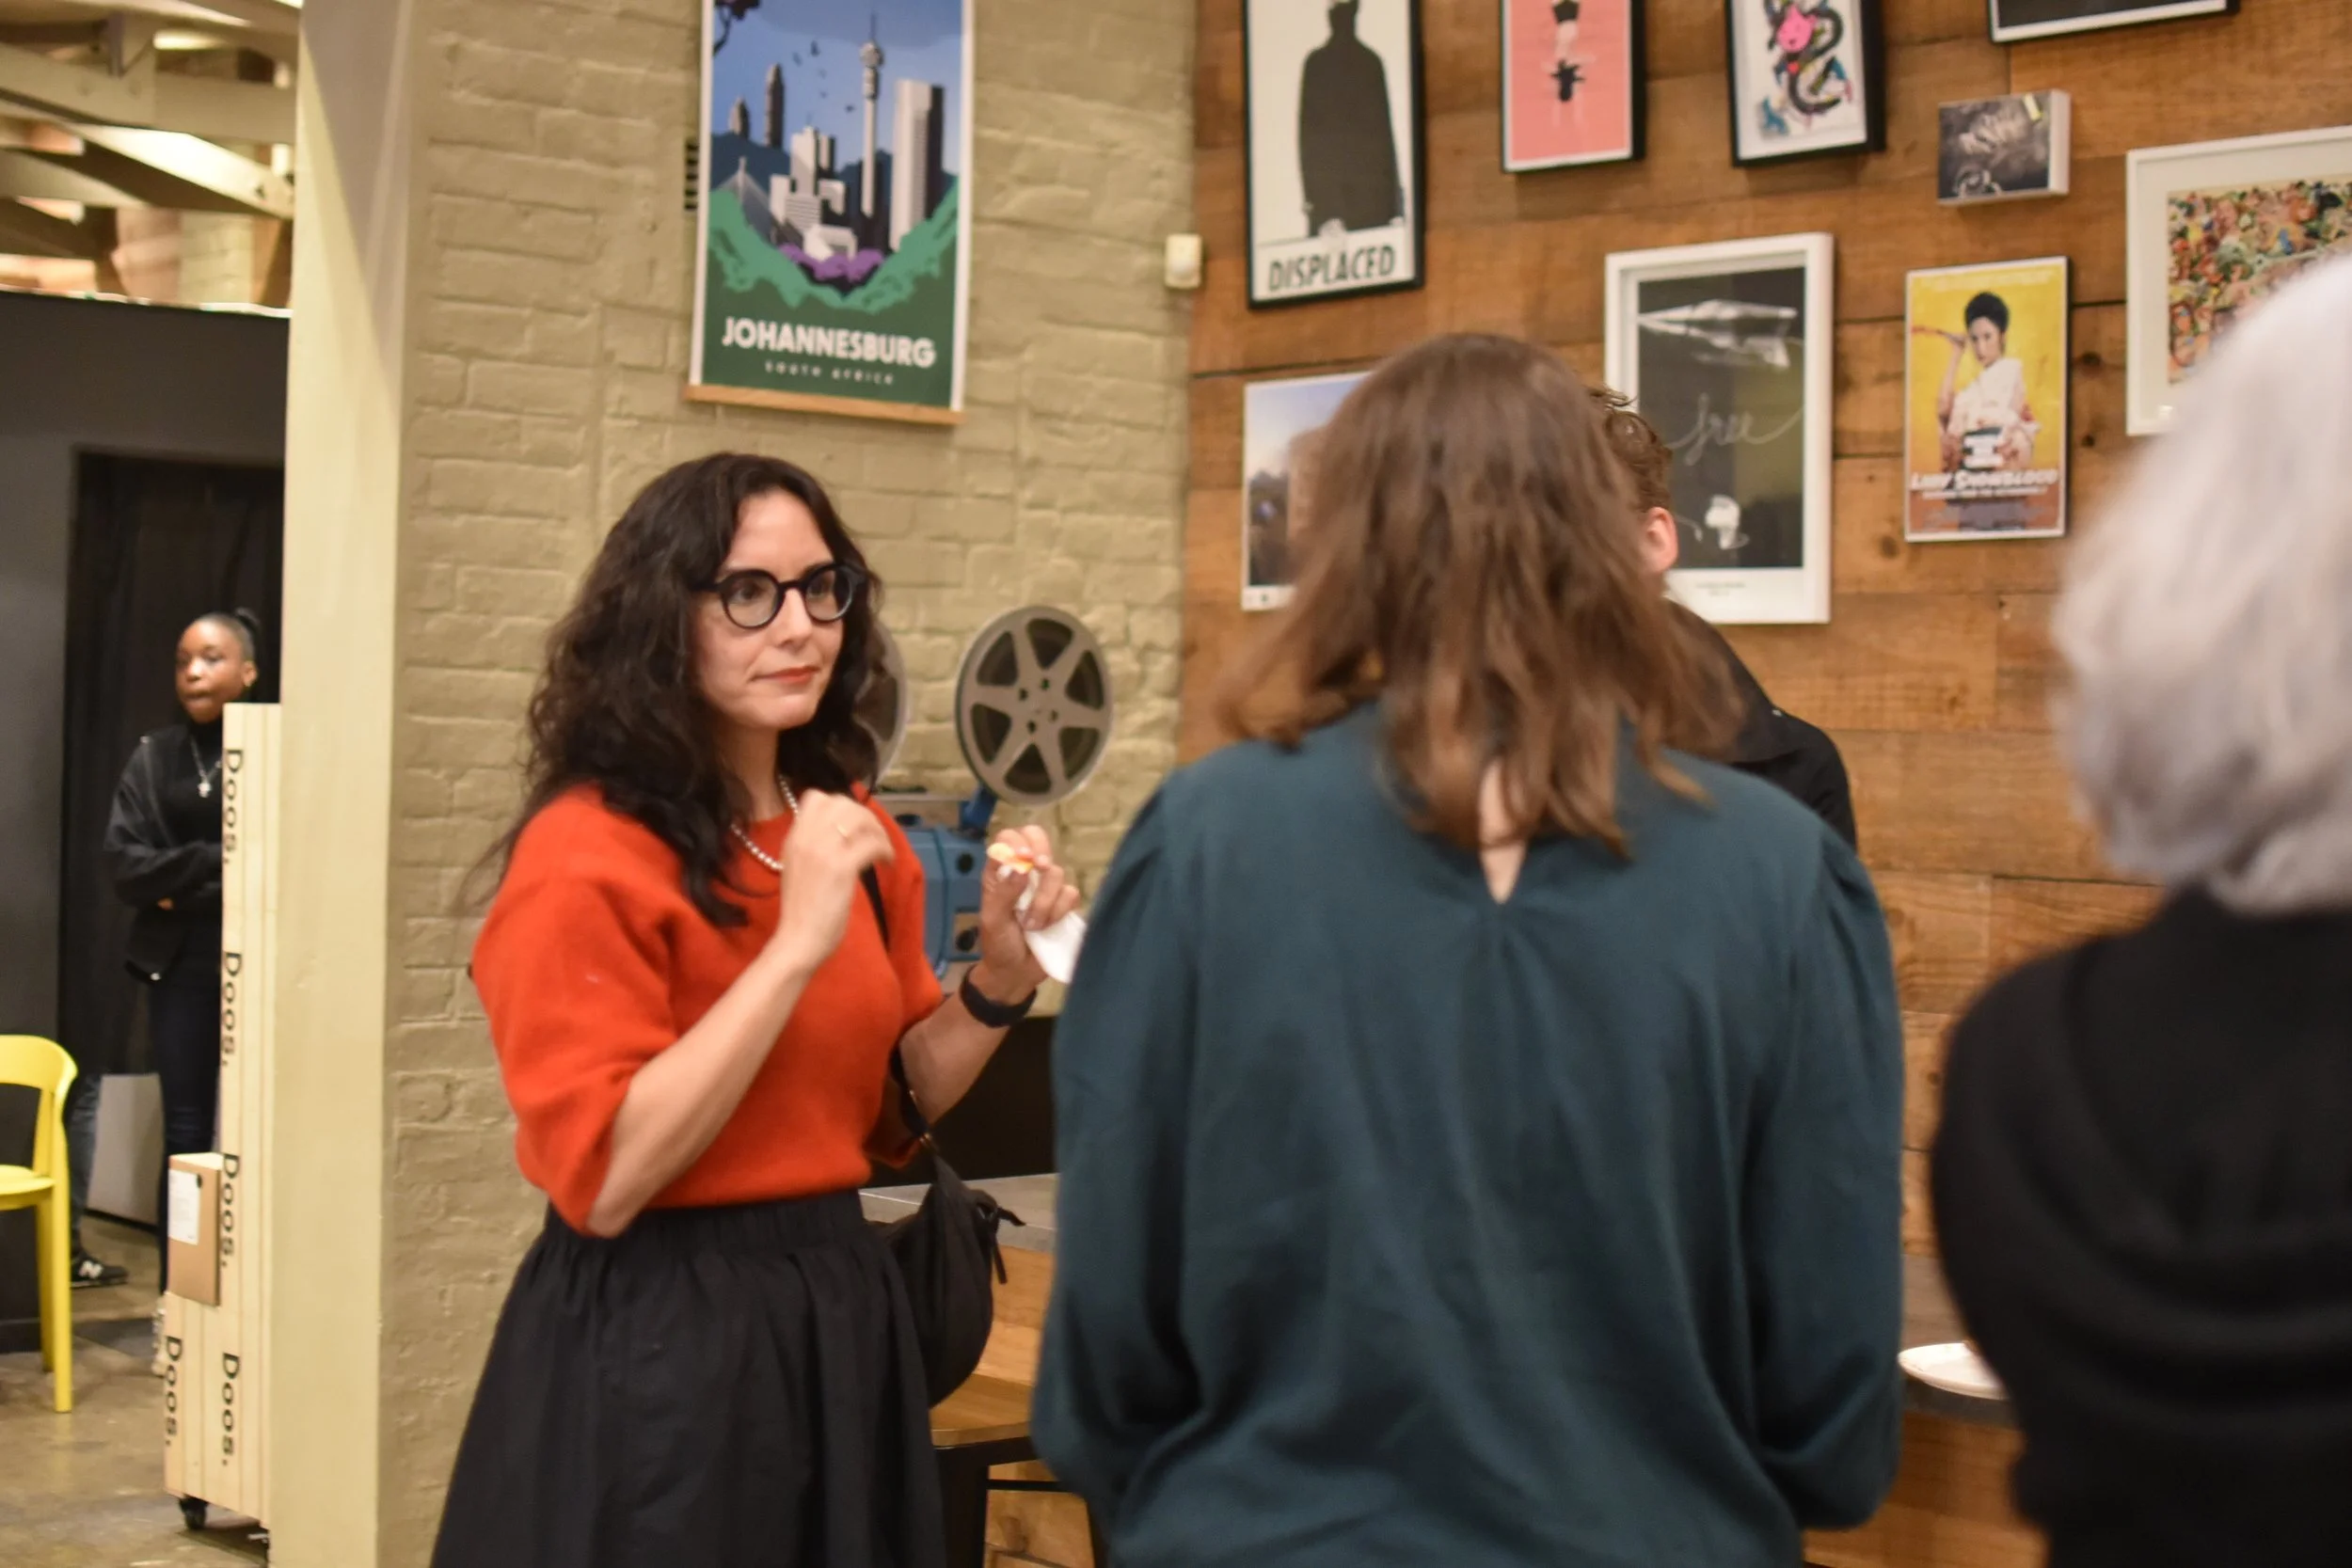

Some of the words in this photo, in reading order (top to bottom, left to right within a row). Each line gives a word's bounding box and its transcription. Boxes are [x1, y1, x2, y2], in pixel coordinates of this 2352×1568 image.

[1268, 244, 1395, 292] DISPLACED
[722, 316, 937, 369] JOHANNESBURG
[764, 359, 821, 377] SOUTH
[832, 367, 895, 386] AFRICA
[223, 749, 243, 863] Doos.
[221, 952, 242, 1067] Doos.
[166, 1336, 183, 1446] Doos.
[222, 1352, 241, 1466] Doos.
